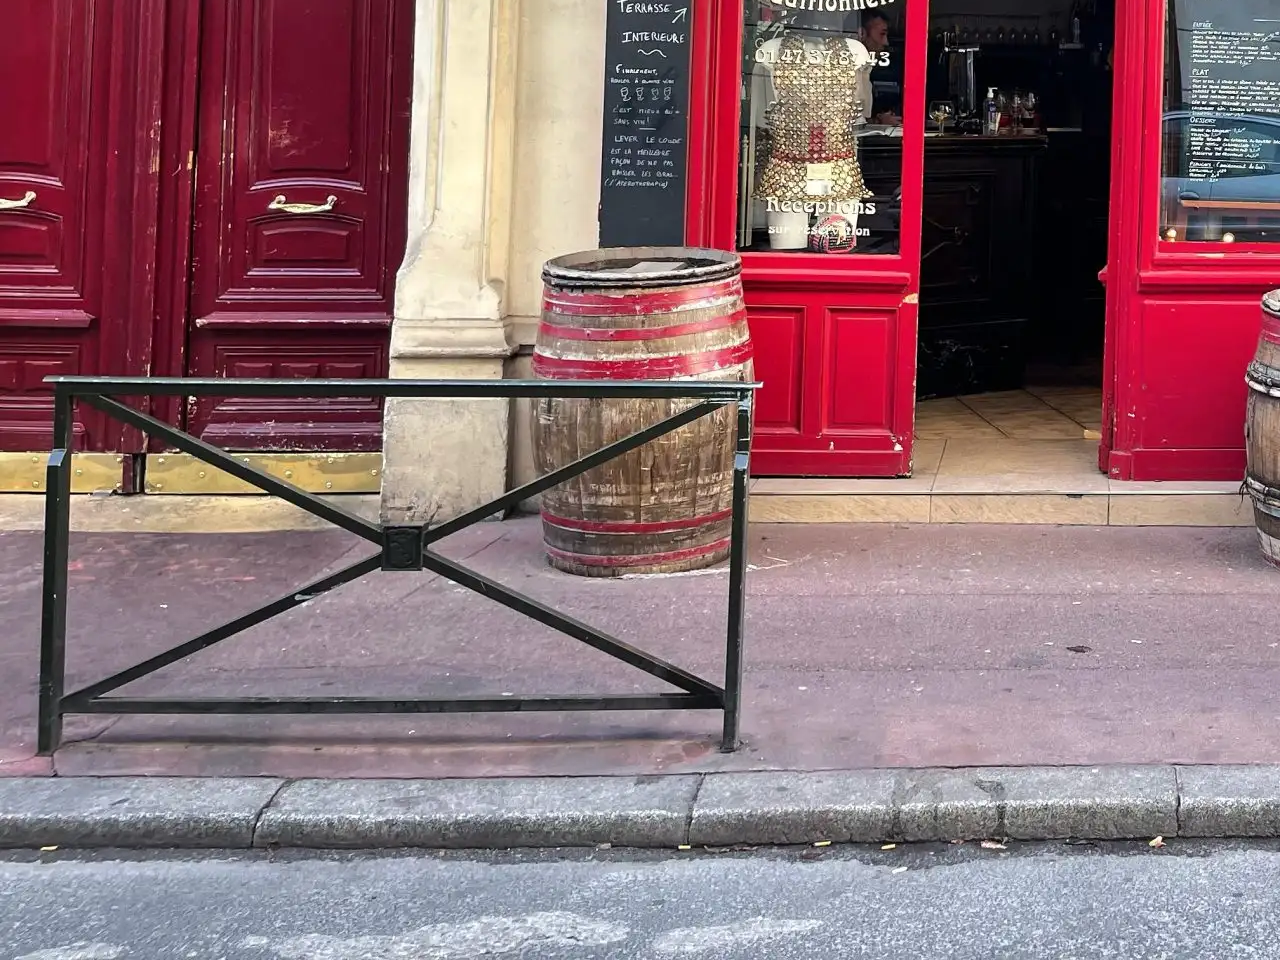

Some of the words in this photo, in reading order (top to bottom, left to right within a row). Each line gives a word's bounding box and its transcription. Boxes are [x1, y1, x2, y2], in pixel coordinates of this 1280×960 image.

[621, 31, 686, 44] INTERIEURE
[614, 135, 639, 143] LEVER
[645, 136, 656, 144] LE
[610, 147, 621, 155] EST
